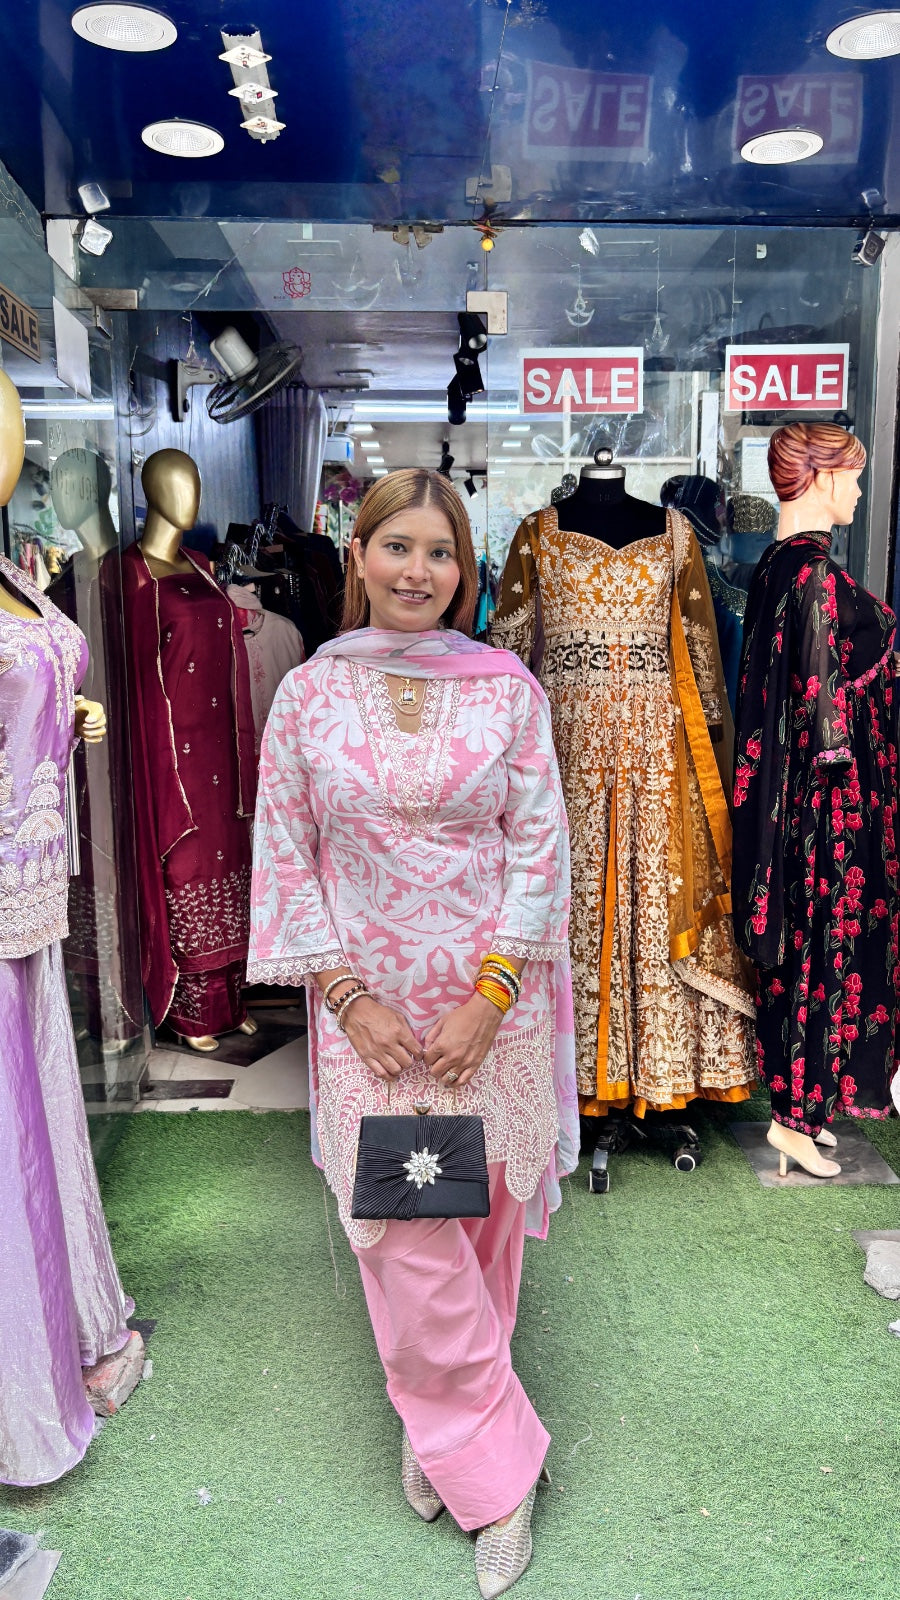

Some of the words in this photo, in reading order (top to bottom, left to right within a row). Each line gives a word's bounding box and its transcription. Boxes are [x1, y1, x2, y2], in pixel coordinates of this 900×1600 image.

[0, 293, 38, 352] SALE
[526, 367, 635, 405] SALE
[732, 363, 840, 402] SALE
